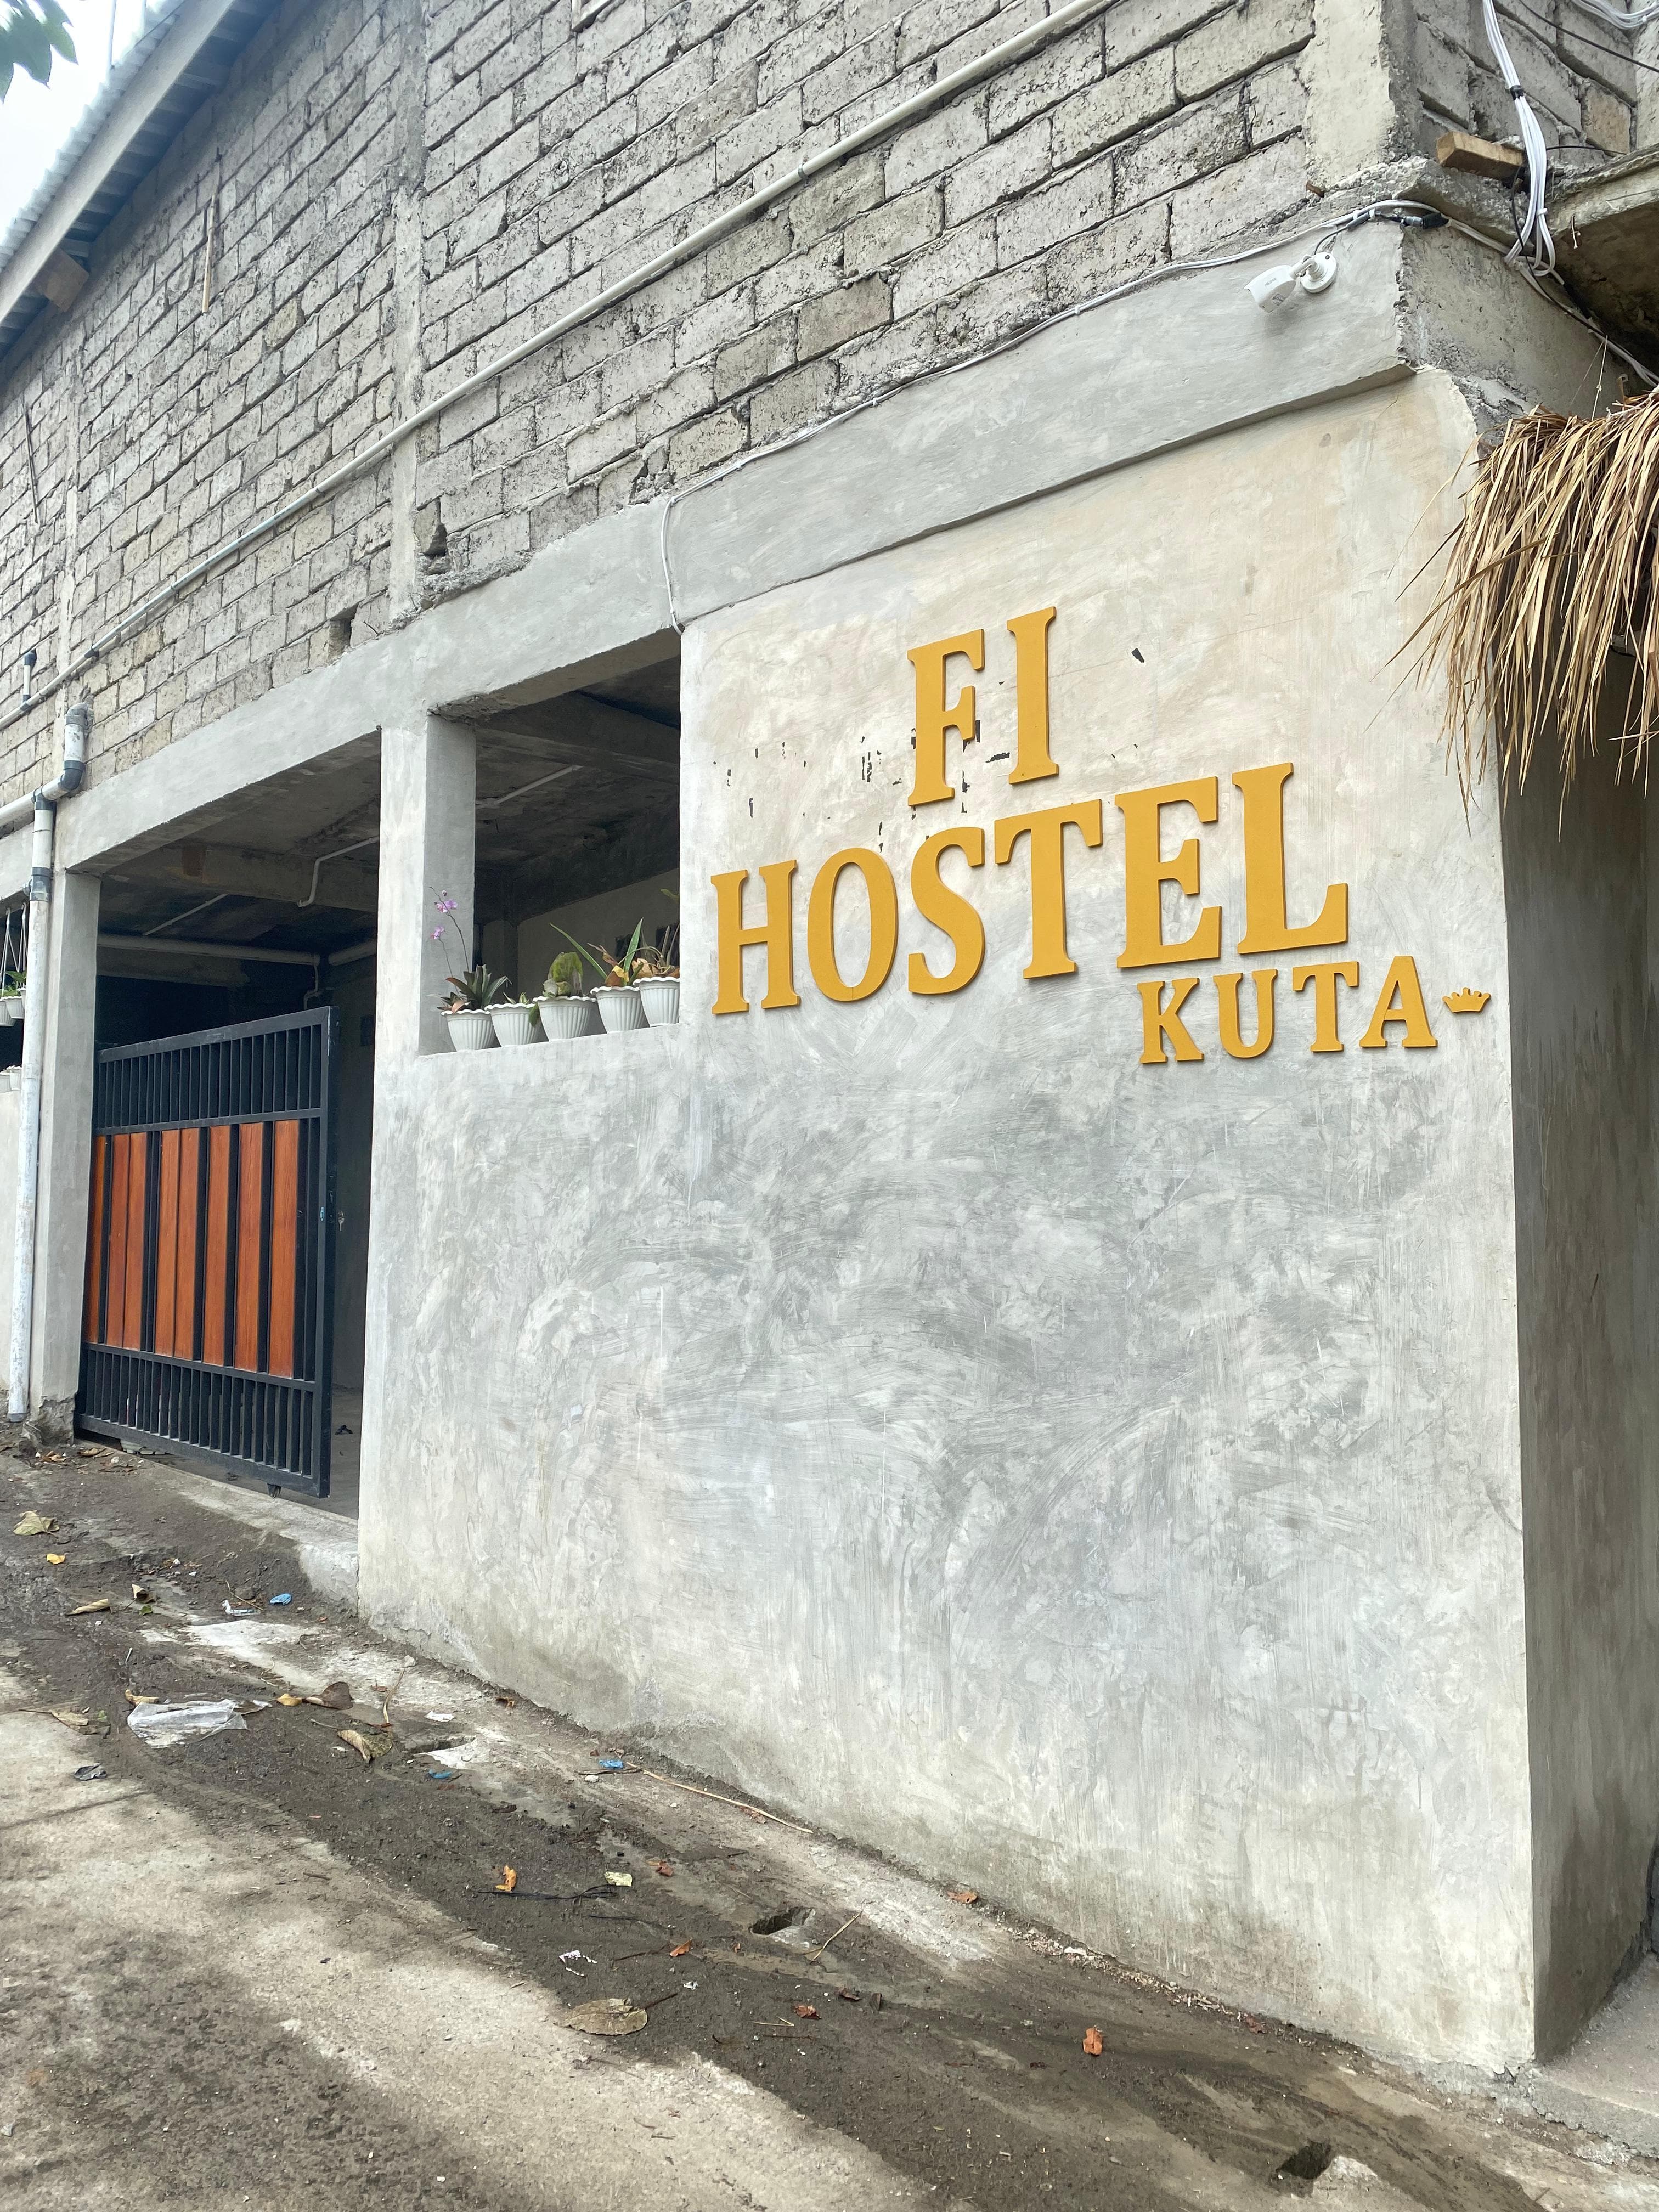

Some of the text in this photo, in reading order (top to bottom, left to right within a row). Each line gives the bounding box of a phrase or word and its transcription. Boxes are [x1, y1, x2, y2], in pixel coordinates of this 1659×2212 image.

[907, 606, 1060, 806] FI
[710, 763, 1348, 1014] HOSTEL
[1137, 956, 1438, 1064] KUTA
